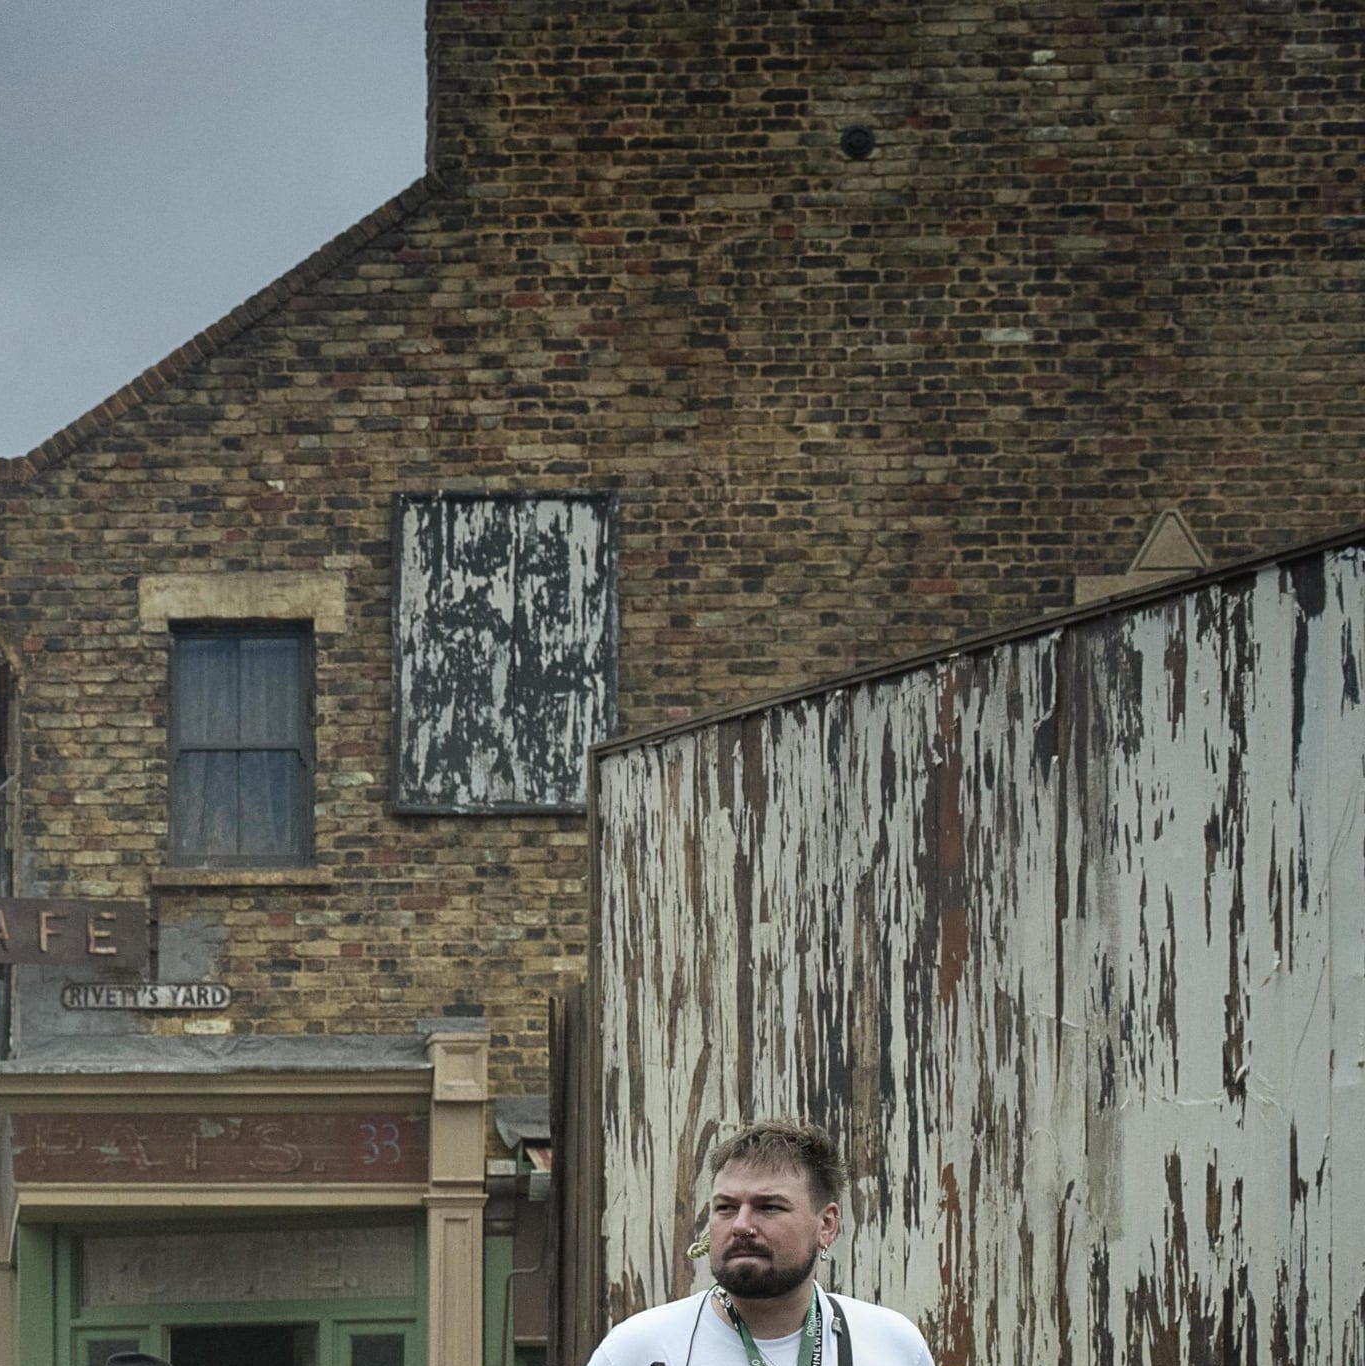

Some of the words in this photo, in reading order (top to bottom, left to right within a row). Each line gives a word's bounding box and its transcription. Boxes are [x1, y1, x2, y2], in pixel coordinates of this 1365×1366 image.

[69, 985, 161, 1006] RIVETT'S
[171, 986, 225, 1006] YARD
[358, 1122, 401, 1164] 33
